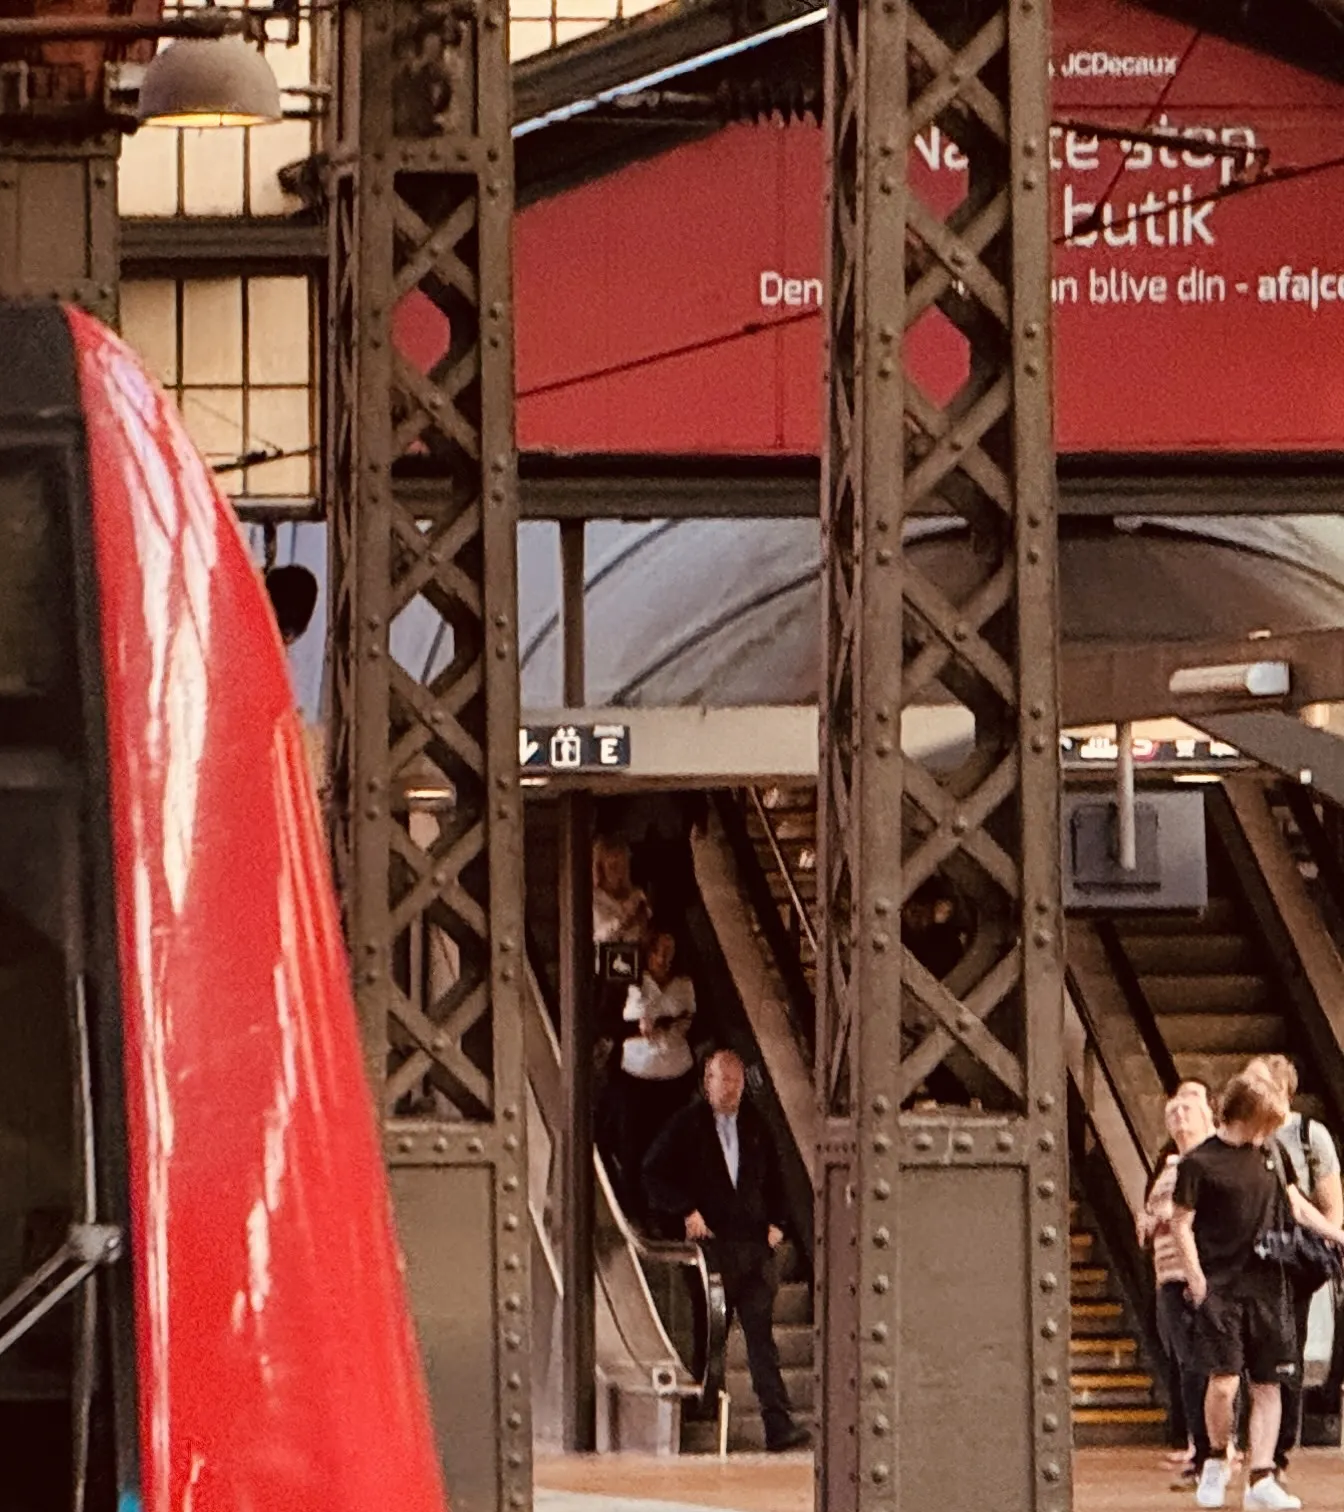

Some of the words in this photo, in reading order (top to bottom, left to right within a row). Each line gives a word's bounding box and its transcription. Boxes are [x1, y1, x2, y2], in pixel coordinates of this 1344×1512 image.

[1061, 51, 1178, 77] JCDecaux
[1120, 113, 1256, 187] stop
[1063, 184, 1215, 248] butik
[1089, 267, 1167, 303] blive
[1177, 266, 1226, 303] din
[600, 738, 619, 764] E
